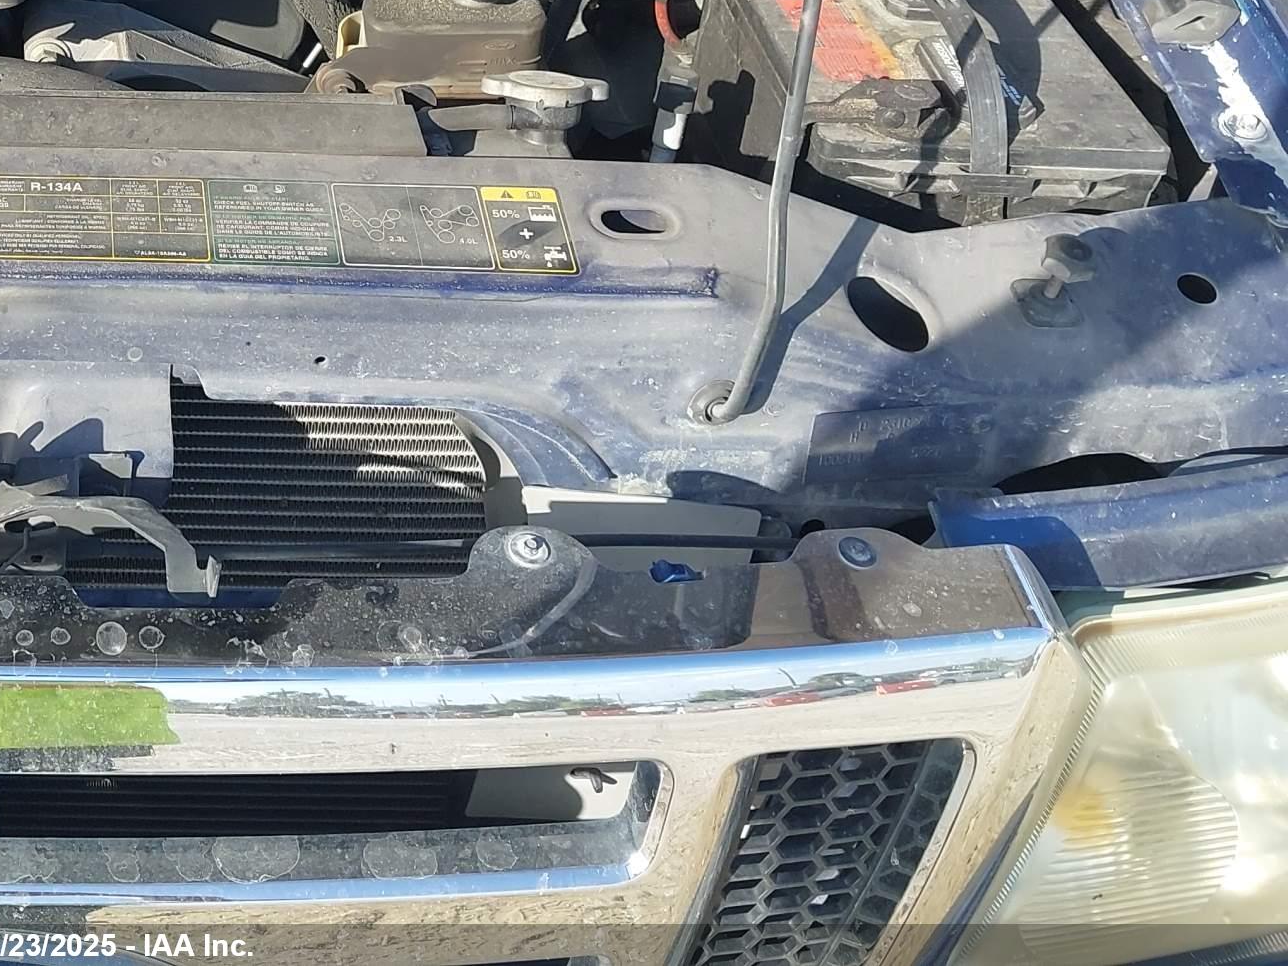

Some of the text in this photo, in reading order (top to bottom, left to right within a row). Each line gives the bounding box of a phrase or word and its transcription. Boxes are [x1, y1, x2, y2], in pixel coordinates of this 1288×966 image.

[30, 182, 83, 192] R-134A
[492, 209, 520, 219] 50%
[502, 250, 530, 260] 50%
